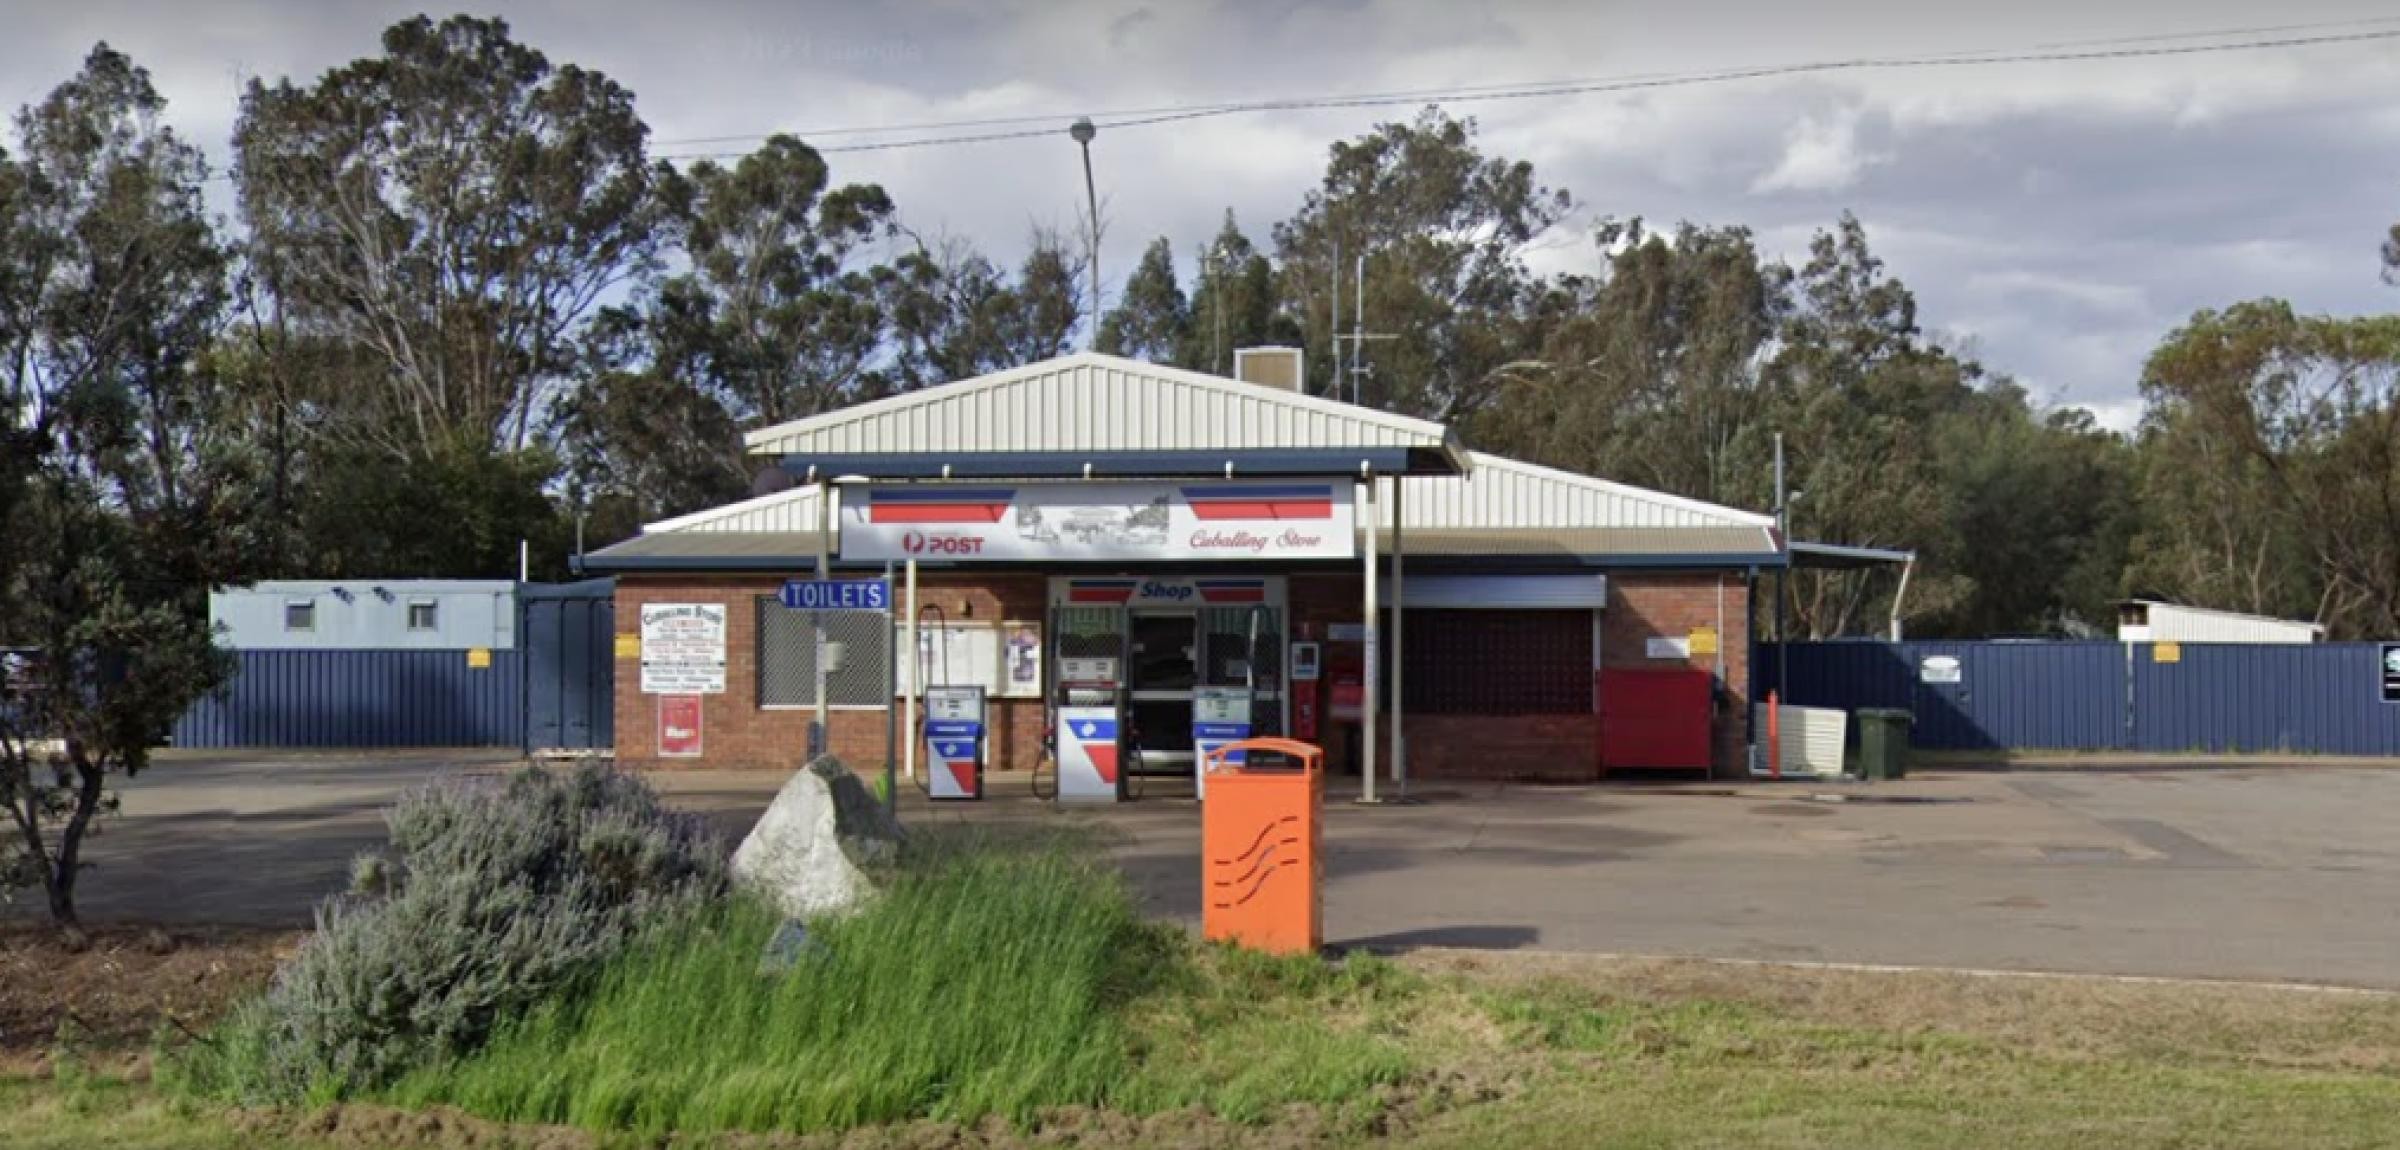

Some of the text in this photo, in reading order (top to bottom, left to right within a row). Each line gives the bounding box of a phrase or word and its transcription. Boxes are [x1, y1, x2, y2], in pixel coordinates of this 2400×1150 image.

[929, 536, 985, 554] POST
[790, 583, 882, 607] TOILETS
[1140, 581, 1192, 601] Shop
